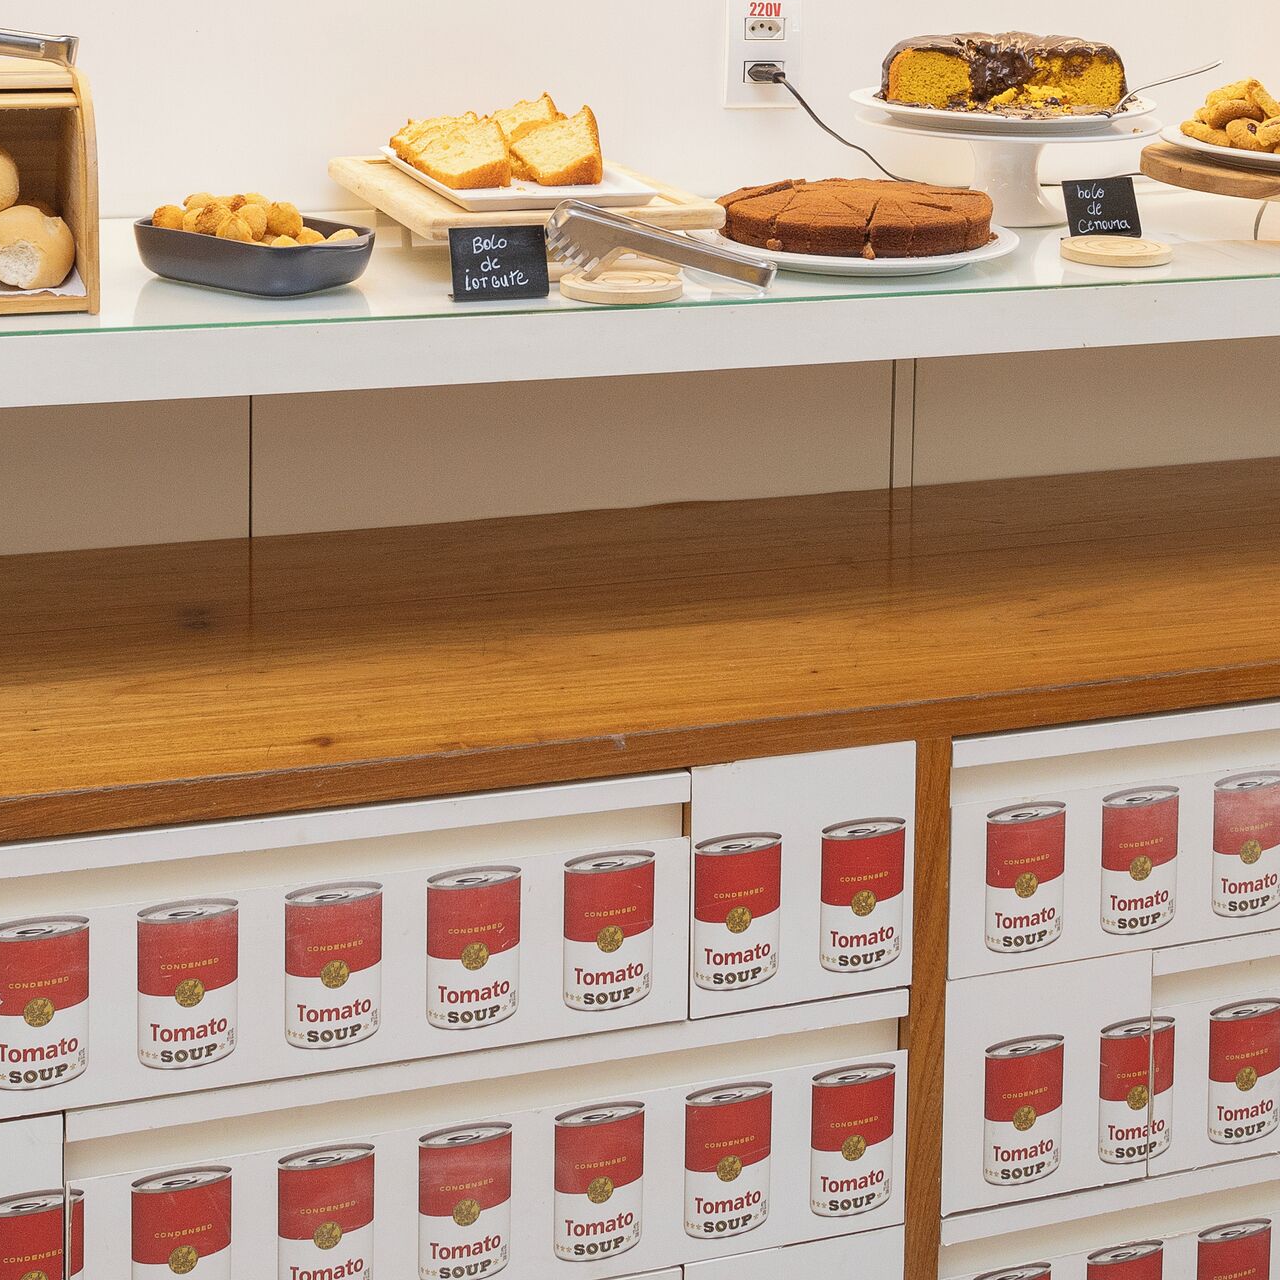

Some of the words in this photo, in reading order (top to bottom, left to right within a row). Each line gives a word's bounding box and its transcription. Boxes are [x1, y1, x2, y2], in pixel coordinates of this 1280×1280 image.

[749, 2, 781, 16] 220V
[1087, 201, 1102, 215] de
[480, 256, 500, 272] de
[840, 870, 890, 883] CONDENSED
[1221, 871, 1279, 895] Tomato
[714, 886, 766, 899] CONDENSED
[1110, 888, 1169, 912] Tomato
[584, 905, 638, 918] CONDENSED
[1228, 894, 1272, 912] SOUP
[995, 905, 1055, 930] Tomato
[1117, 911, 1162, 929] SOUP
[448, 922, 503, 935] CONDENSED
[831, 923, 895, 949] Tomato
[1002, 929, 1048, 947] SOUP
[308, 938, 364, 952] CONDENSED
[704, 941, 771, 966] Tomato
[161, 957, 219, 971] CONDENSED
[838, 948, 887, 966] SOUP
[8, 975, 70, 990] CONDENSED
[574, 961, 643, 987] Tomato
[712, 966, 763, 985] SOUP
[438, 978, 509, 1004] Tomato
[583, 986, 635, 1005] SOUP
[297, 995, 370, 1022] Tomato
[446, 1004, 501, 1023] SOUP
[152, 1016, 228, 1043] Tomato
[306, 1021, 362, 1041] SOUP
[0, 1035, 78, 1064] Tomato
[161, 1042, 218, 1063] SOUP
[8, 1063, 68, 1084] SOUP
[1216, 1098, 1273, 1121] Tomato
[830, 1115, 880, 1128] CONDENSED
[1108, 1117, 1165, 1141] Tomato
[1223, 1121, 1267, 1138] SOUP
[705, 1135, 756, 1147] CONDENSED
[992, 1137, 1053, 1162] Tomato
[1115, 1140, 1158, 1158] SOUP
[574, 1155, 628, 1168] CONDENSED
[1000, 1161, 1046, 1179] SOUP
[440, 1177, 494, 1190] CONDENSED
[821, 1168, 885, 1193] Tomato
[300, 1200, 357, 1213] CONDENSED
[695, 1189, 761, 1214] Tomato
[829, 1192, 877, 1211] SOUP
[154, 1225, 212, 1238] CONDENSED
[565, 1210, 633, 1236] Tomato
[703, 1213, 753, 1232] SOUP
[430, 1233, 500, 1259] Tomato
[573, 1236, 625, 1255] SOUP
[290, 1257, 363, 1280] Tomato
[439, 1258, 492, 1278] SOUP
